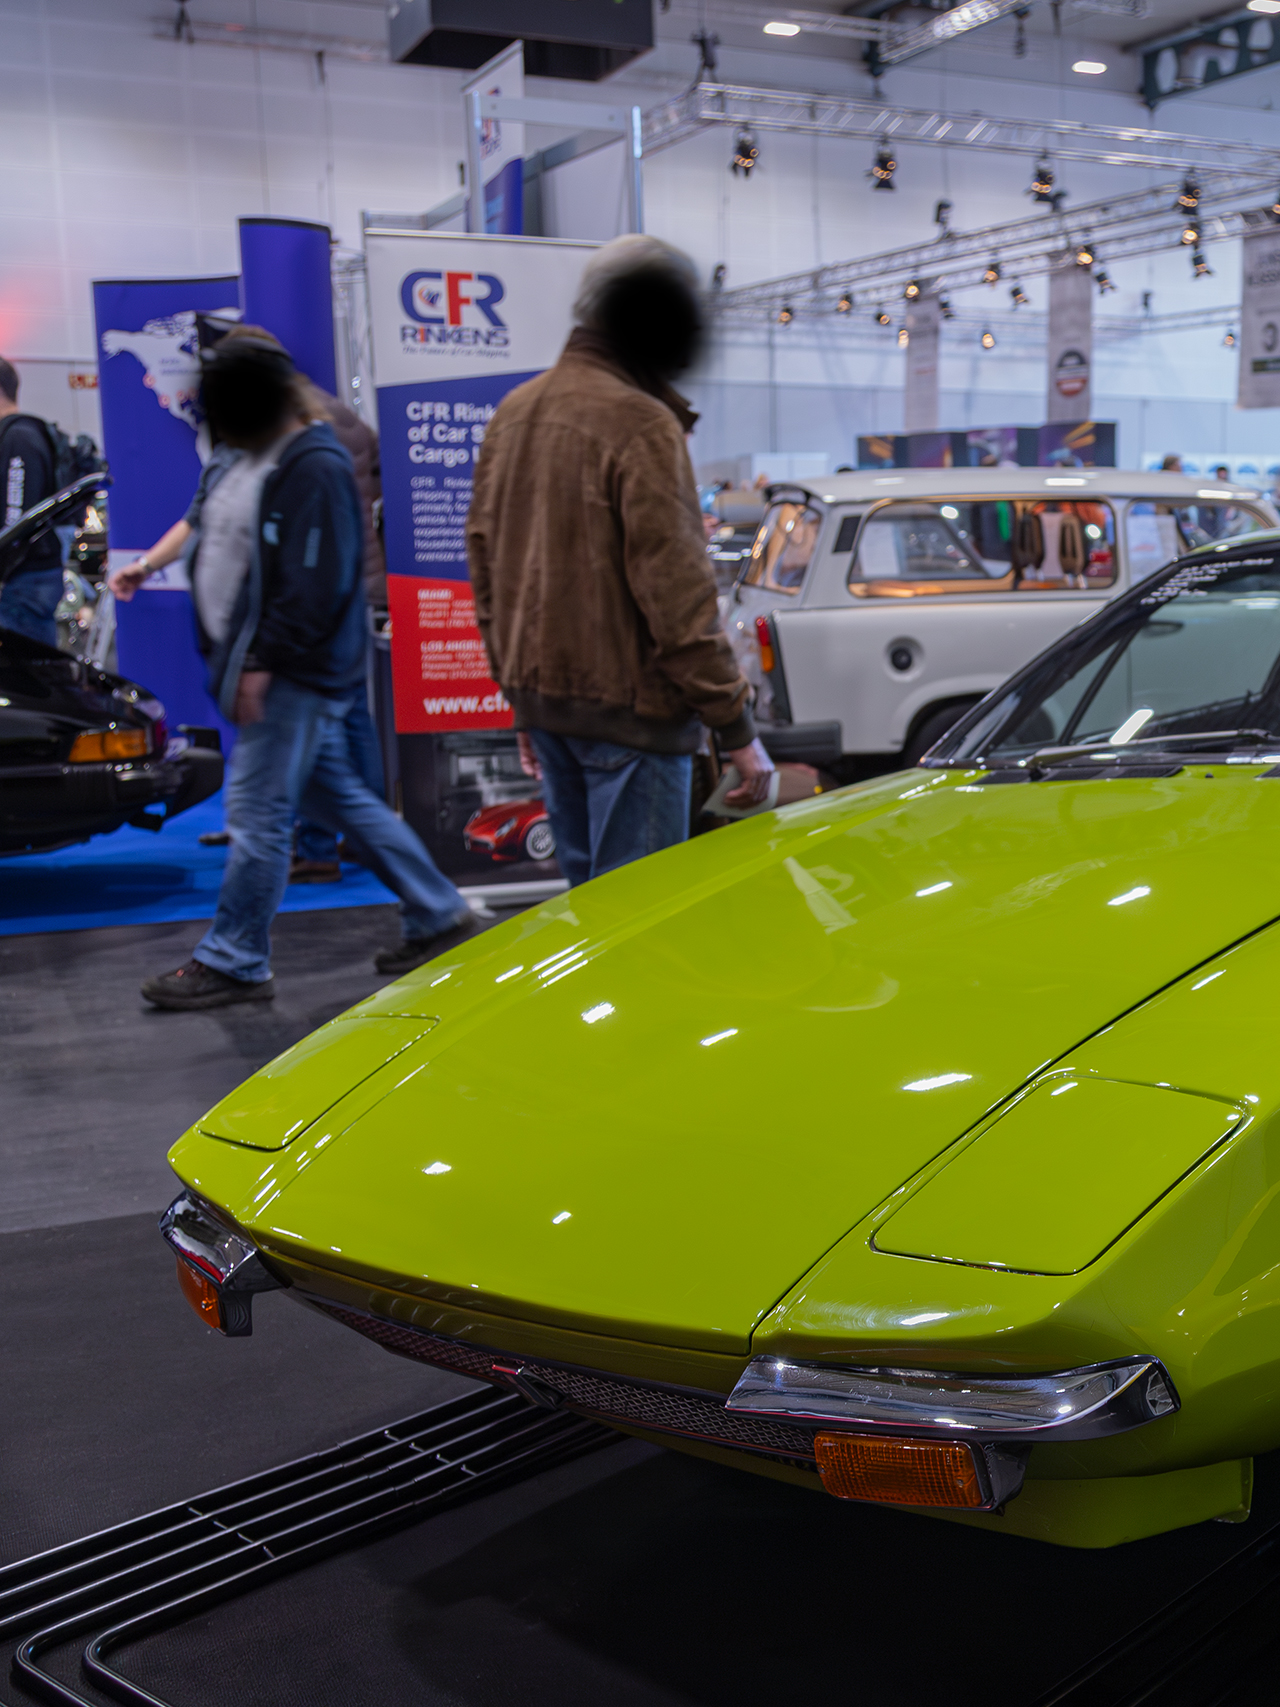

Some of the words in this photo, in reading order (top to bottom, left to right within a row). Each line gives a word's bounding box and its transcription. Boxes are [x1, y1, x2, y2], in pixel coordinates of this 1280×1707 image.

[401, 271, 507, 328] CFR
[401, 325, 510, 346] RINKENS
[406, 401, 451, 421] CFR
[407, 422, 431, 442] of
[432, 423, 468, 443] Car
[408, 443, 469, 468] Cargo
